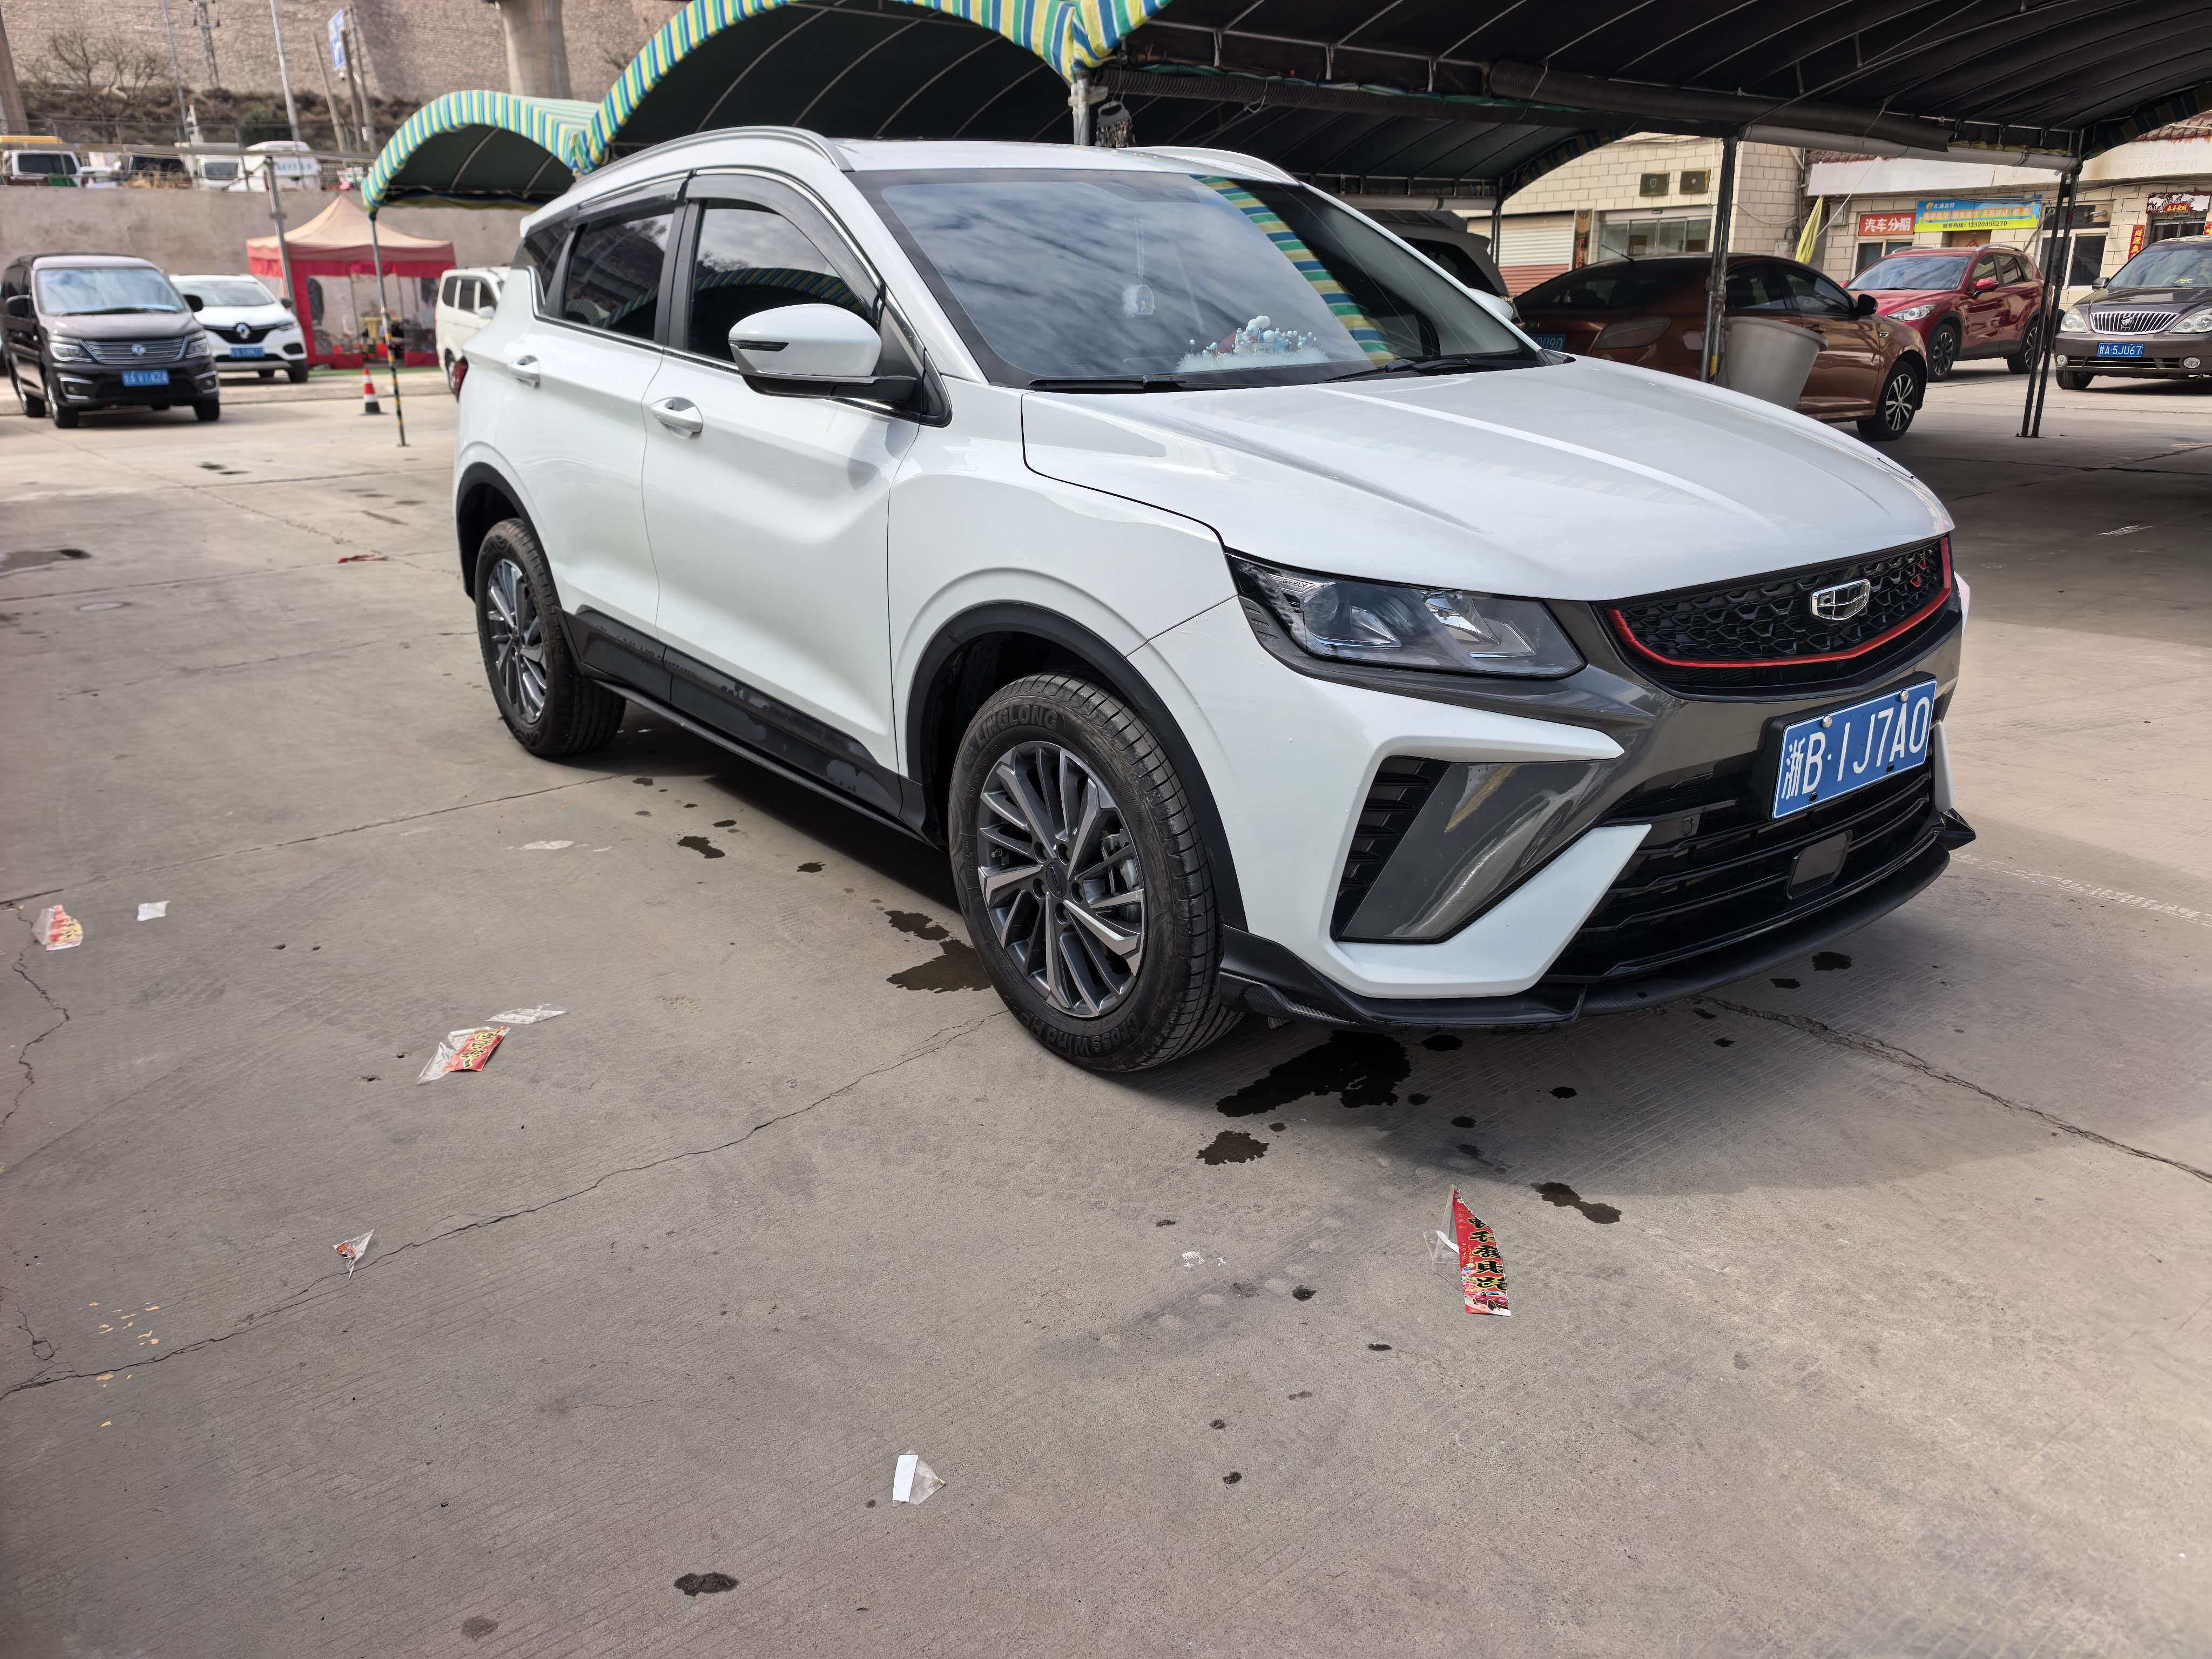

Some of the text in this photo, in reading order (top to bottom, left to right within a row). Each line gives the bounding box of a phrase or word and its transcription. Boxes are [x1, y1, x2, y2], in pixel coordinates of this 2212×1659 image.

[1864, 217, 1911, 232] 汽车分期
[1283, 578, 1307, 588] GEELY
[975, 704, 1058, 749] LINGLONG
